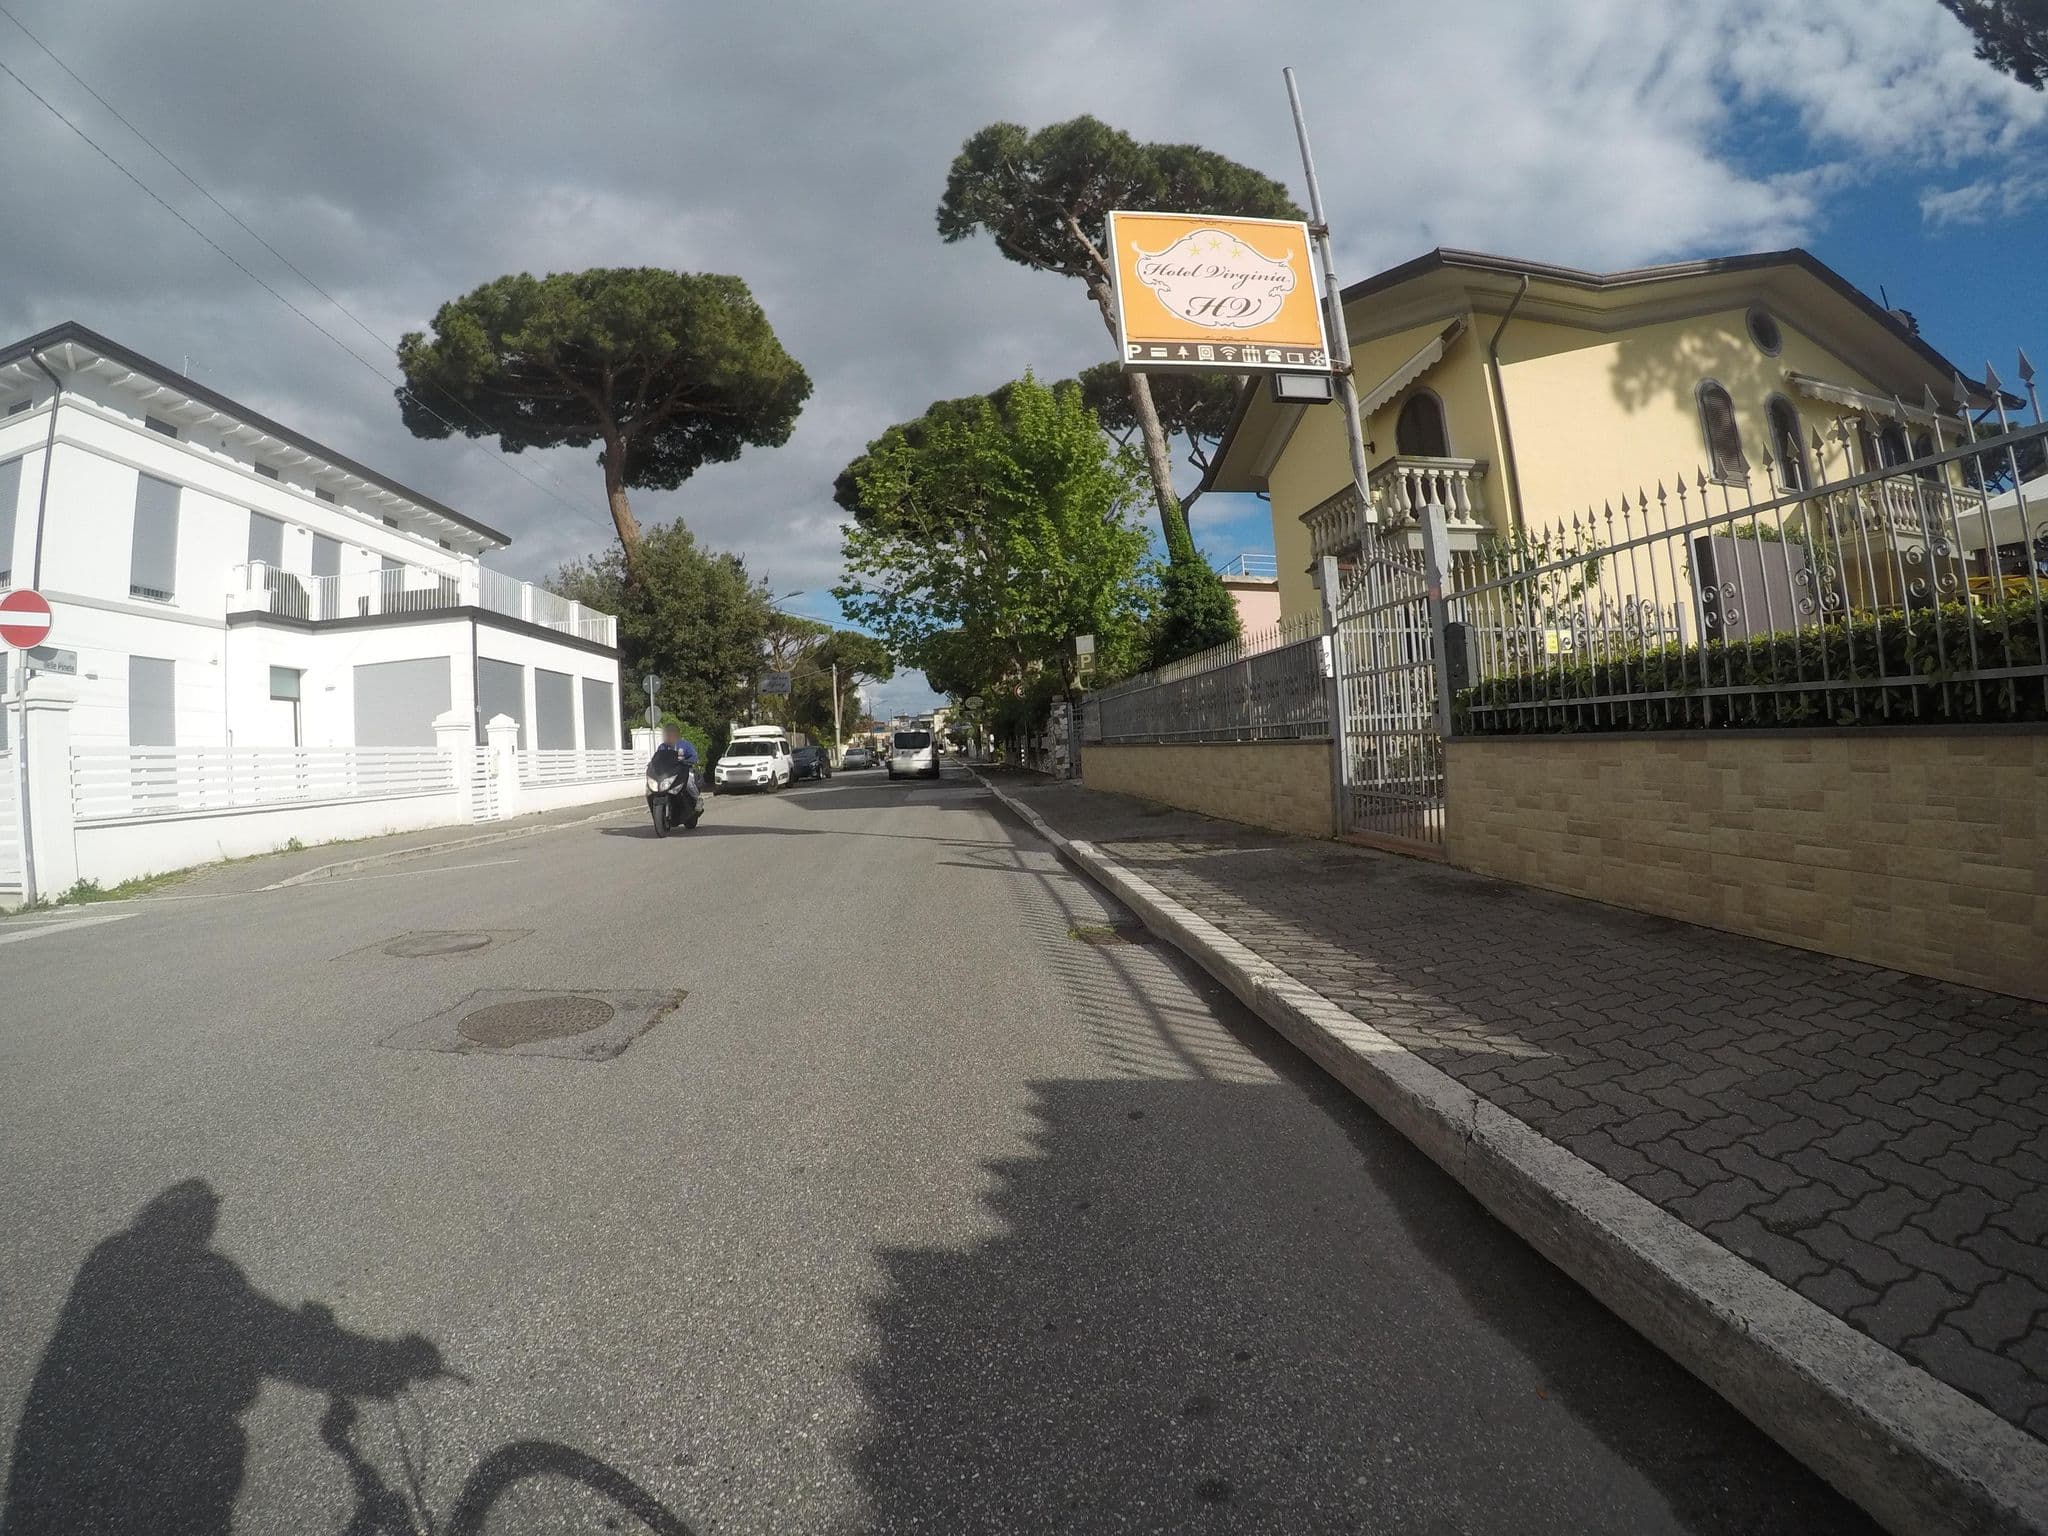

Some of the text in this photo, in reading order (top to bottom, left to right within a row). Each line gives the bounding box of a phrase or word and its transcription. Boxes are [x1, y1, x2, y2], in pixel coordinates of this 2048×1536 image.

[1143, 262, 1288, 290] Hotel Virginia
[1185, 296, 1262, 319] HV
[1128, 345, 1142, 359] P
[1080, 654, 1092, 669] P
